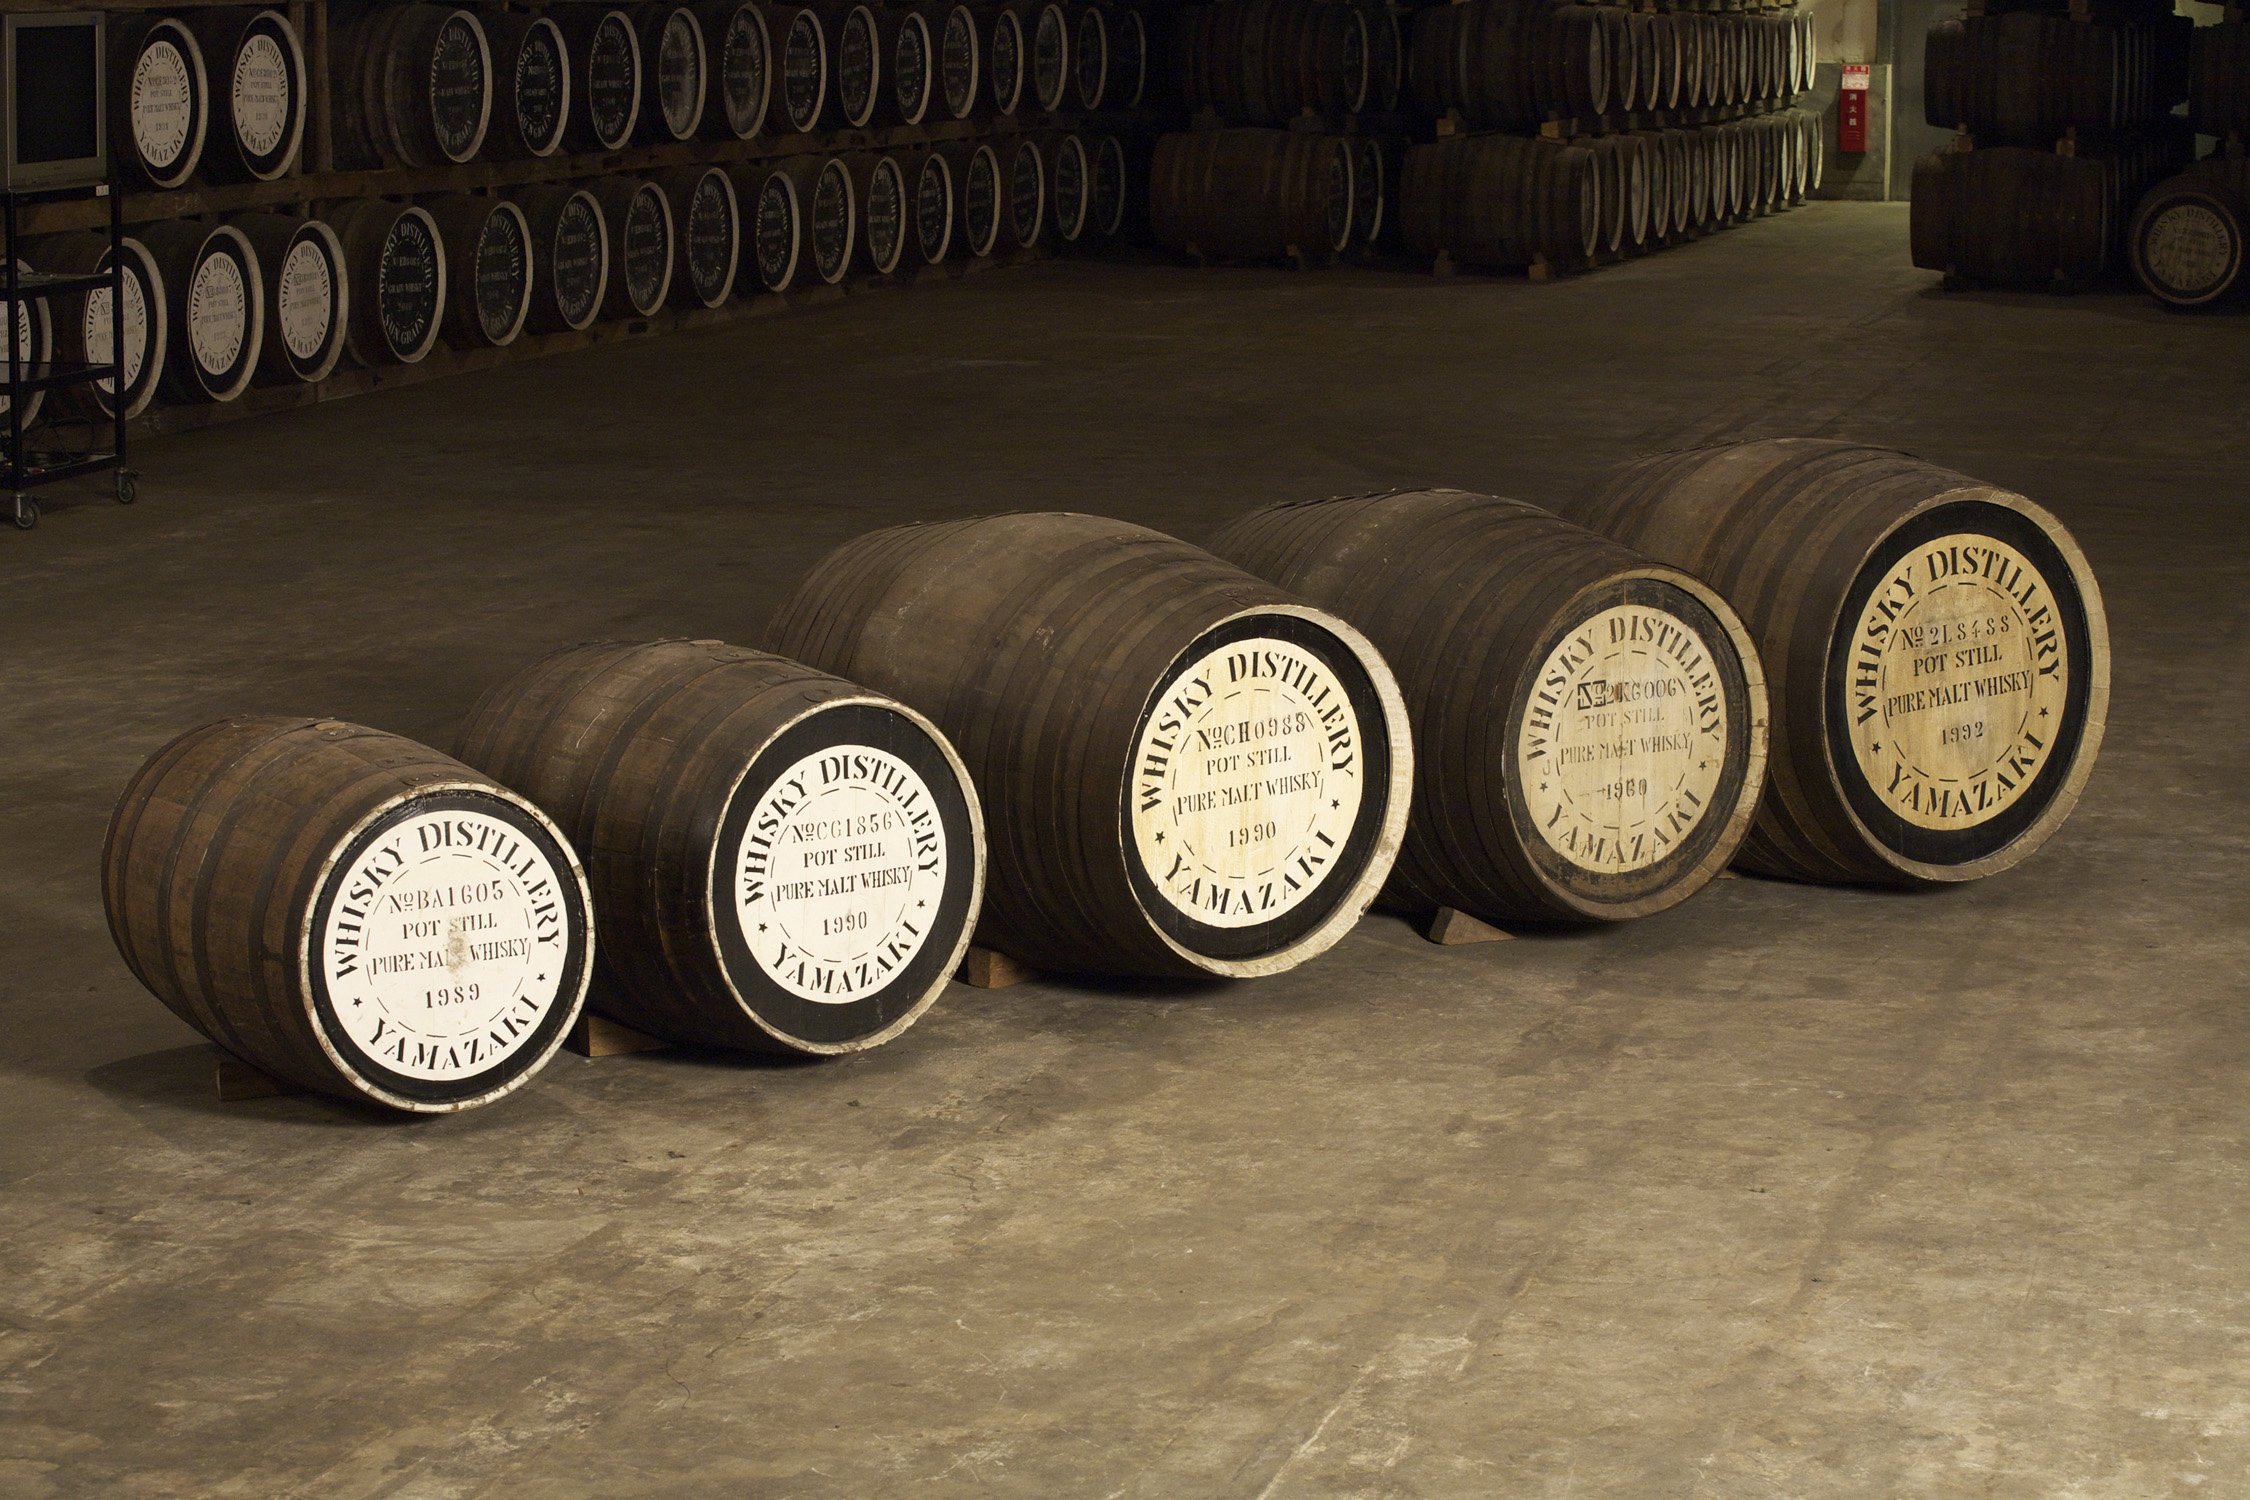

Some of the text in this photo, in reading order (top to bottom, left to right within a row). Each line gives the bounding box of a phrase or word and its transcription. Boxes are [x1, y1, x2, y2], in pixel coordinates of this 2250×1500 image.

[1855, 546, 2059, 726] WHISKY DISTILLERY
[1913, 644, 2002, 677] POT STILL
[1527, 615, 1719, 762] WHISKY DISTILLERY
[1888, 669, 2031, 717] PURE MALT WHISKY
[1141, 651, 1354, 813] WHISKY DISTILLERY
[1585, 708, 1664, 729] POT STILL
[1941, 721, 1984, 745] 1992
[1206, 745, 1291, 776] POT STILL
[1561, 731, 1692, 765] PURE MALT WHISKY
[1177, 770, 1321, 815] PURE MALT WHISKY
[1887, 730, 2044, 818] YAMAZAKI
[744, 754, 938, 906] WHISKY DISTILLERY
[1229, 820, 1276, 848] 1990
[1547, 789, 1700, 864] YAMAZAKI
[803, 842, 886, 868] POT STILL
[1165, 830, 1335, 915] YAMAZAKI
[335, 821, 559, 980] WHISKY DISTILLERY
[776, 865, 910, 902] PURE MALT WHISKY
[402, 913, 497, 939] POT STILL
[823, 911, 868, 936] 1990
[372, 937, 528, 975] PURE MAL WHISKY
[773, 920, 919, 994] YAMAZAKI
[426, 983, 480, 1009] 1989
[369, 994, 540, 1070] YAMAZAKI
